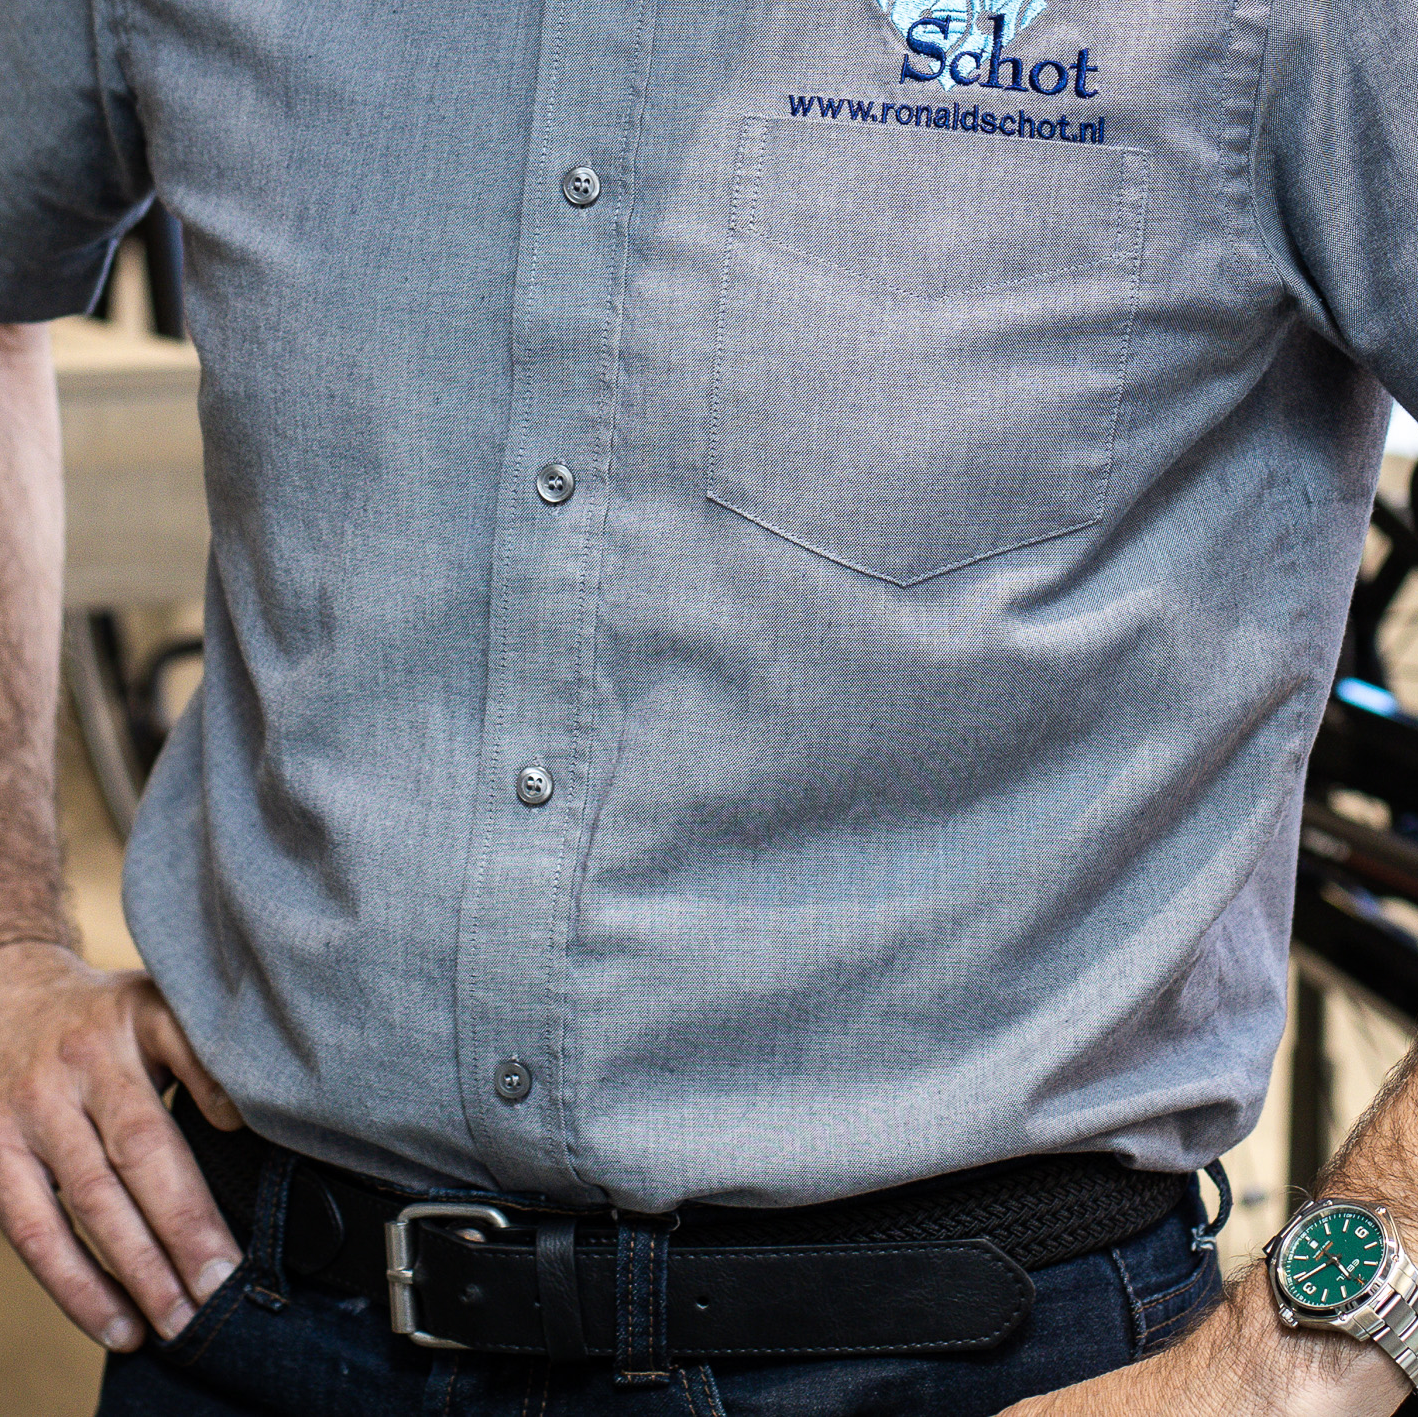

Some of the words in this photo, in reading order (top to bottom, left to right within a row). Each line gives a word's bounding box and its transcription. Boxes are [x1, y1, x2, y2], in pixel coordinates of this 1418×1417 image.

[899, 13, 1099, 99] Schot
[787, 93, 1106, 145] www.ronaldschot.nl
[1302, 1281, 1317, 1295] 3
[1335, 1258, 1361, 1282] EBL
